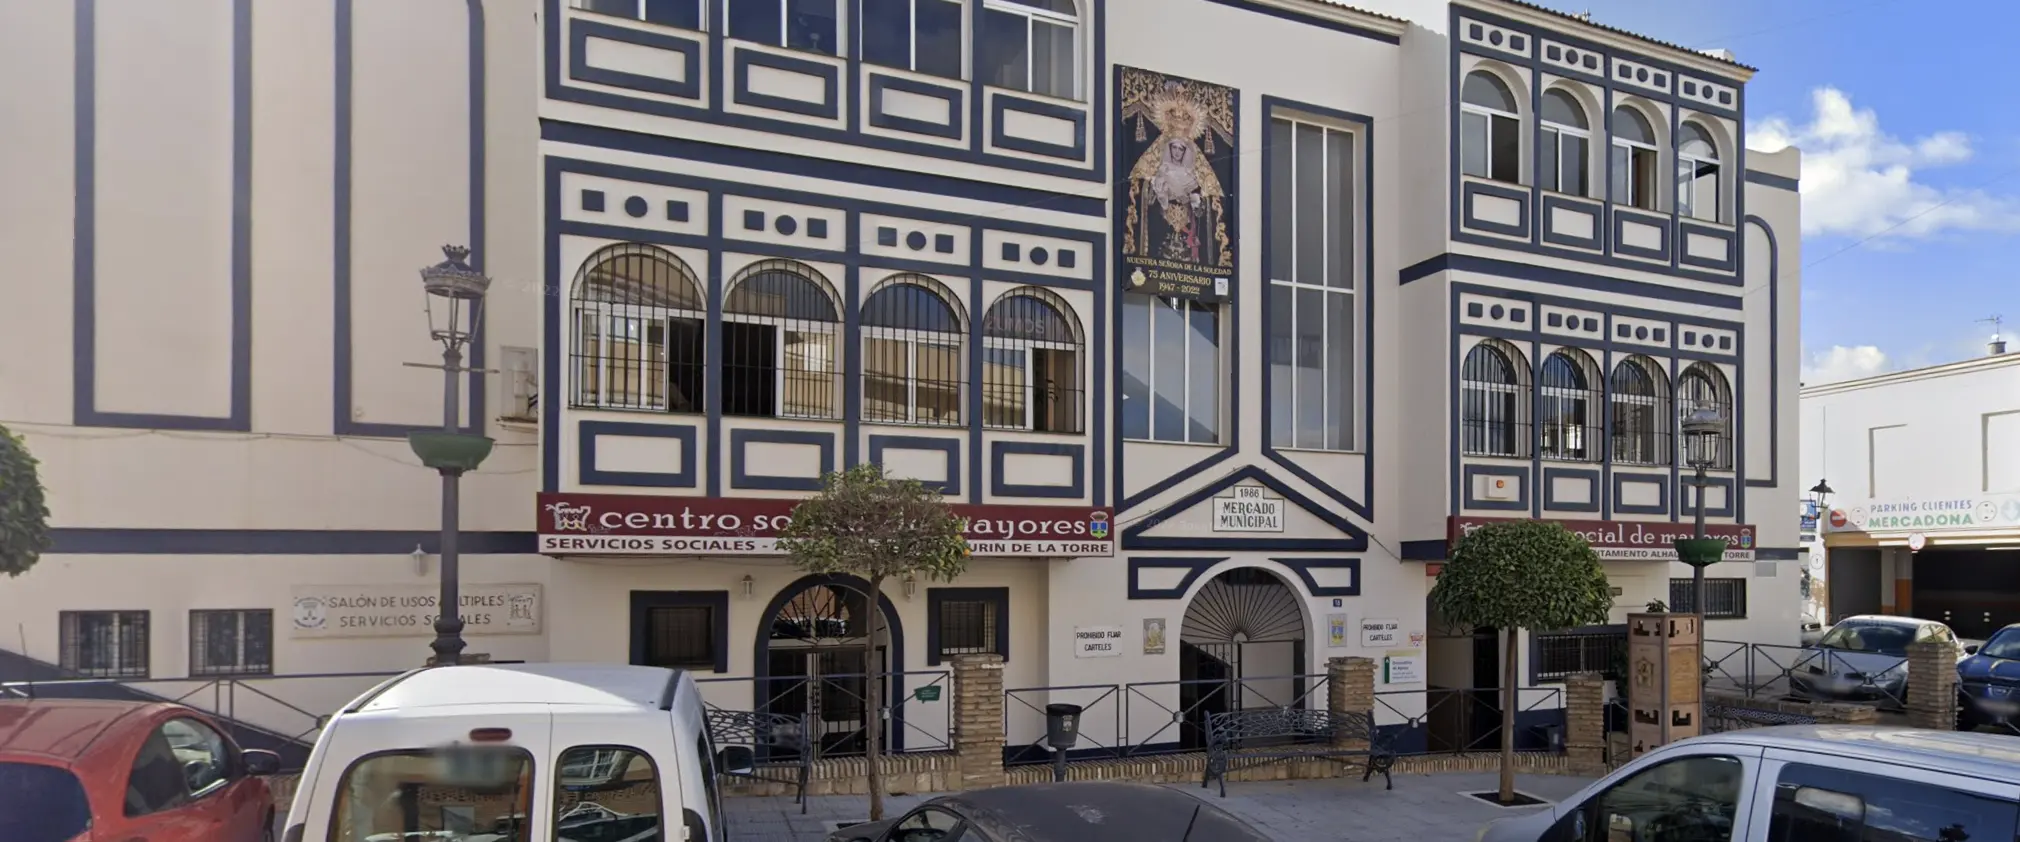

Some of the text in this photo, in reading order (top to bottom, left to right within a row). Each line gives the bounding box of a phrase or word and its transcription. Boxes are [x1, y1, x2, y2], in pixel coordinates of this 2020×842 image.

[1126, 256, 1232, 276] NUESTRA SEÑORA DE LA SOLEDAD
[1148, 269, 1212, 286] 75 ANIVERSARIO
[1158, 282, 1176, 291] 1947
[1181, 285, 1200, 295] 2022
[1239, 488, 1260, 498] 1986
[1222, 501, 1275, 516] MERCADO
[1870, 499, 1973, 514] PARKING CLIENTES
[599, 506, 741, 531] centro
[1220, 515, 1279, 528] MUNICIPAL
[1868, 513, 1974, 529] MERCADONA
[1574, 524, 1624, 544] ocial
[1629, 524, 1655, 544] de
[545, 537, 655, 551] SERVICIOS
[662, 538, 756, 551] SOCIALES
[1011, 542, 1032, 553] DE
[1037, 542, 1056, 553] LA
[1060, 543, 1109, 554] TORRE
[1723, 551, 1750, 559] TORRE
[328, 594, 377, 608] SALÓN
[381, 596, 397, 608] DE
[401, 596, 436, 607] USOS
[340, 614, 417, 628] SERVICIOS
[1363, 623, 1384, 631] PROHIBIDO
[1076, 631, 1105, 639] PROHIBIDO
[1369, 633, 1393, 641] CARTELES
[1084, 643, 1112, 651] CARTELES
